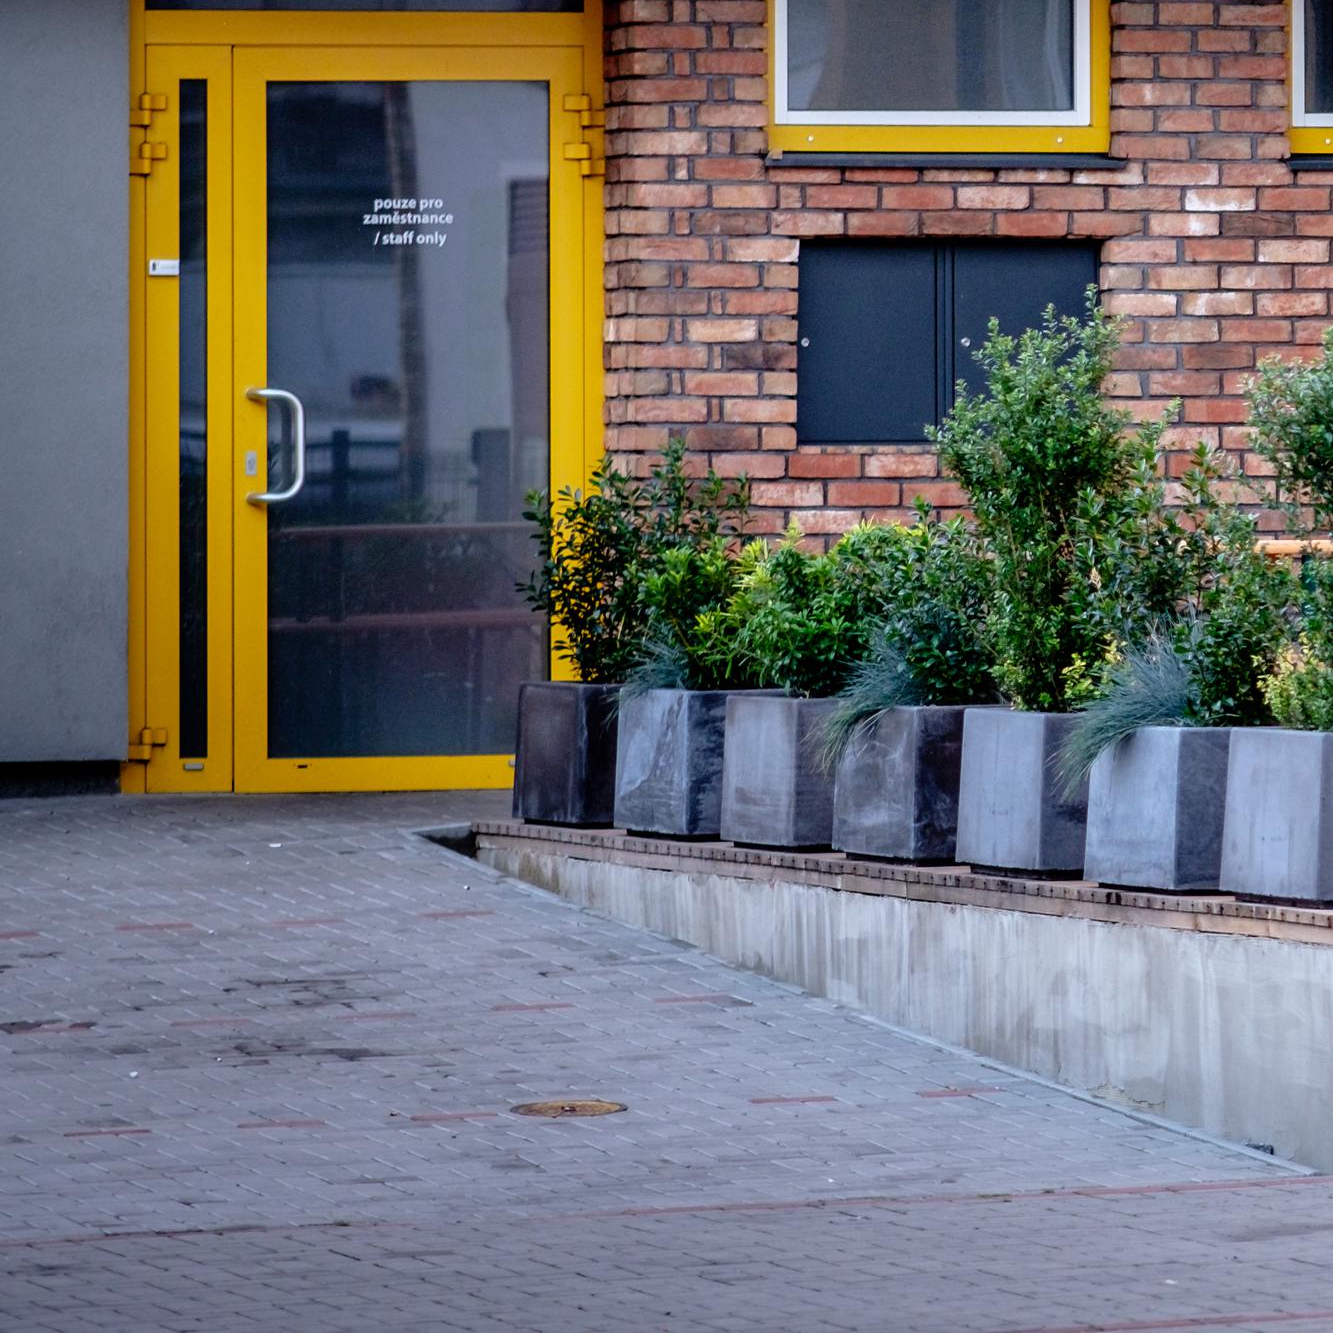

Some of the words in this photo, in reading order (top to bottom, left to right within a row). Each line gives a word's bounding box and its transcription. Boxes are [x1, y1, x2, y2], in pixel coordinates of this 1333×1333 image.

[373, 198, 417, 212] pouze
[419, 198, 443, 212] pro
[362, 211, 454, 225] zaměstnance
[382, 230, 415, 245] staff
[416, 230, 447, 247] only
